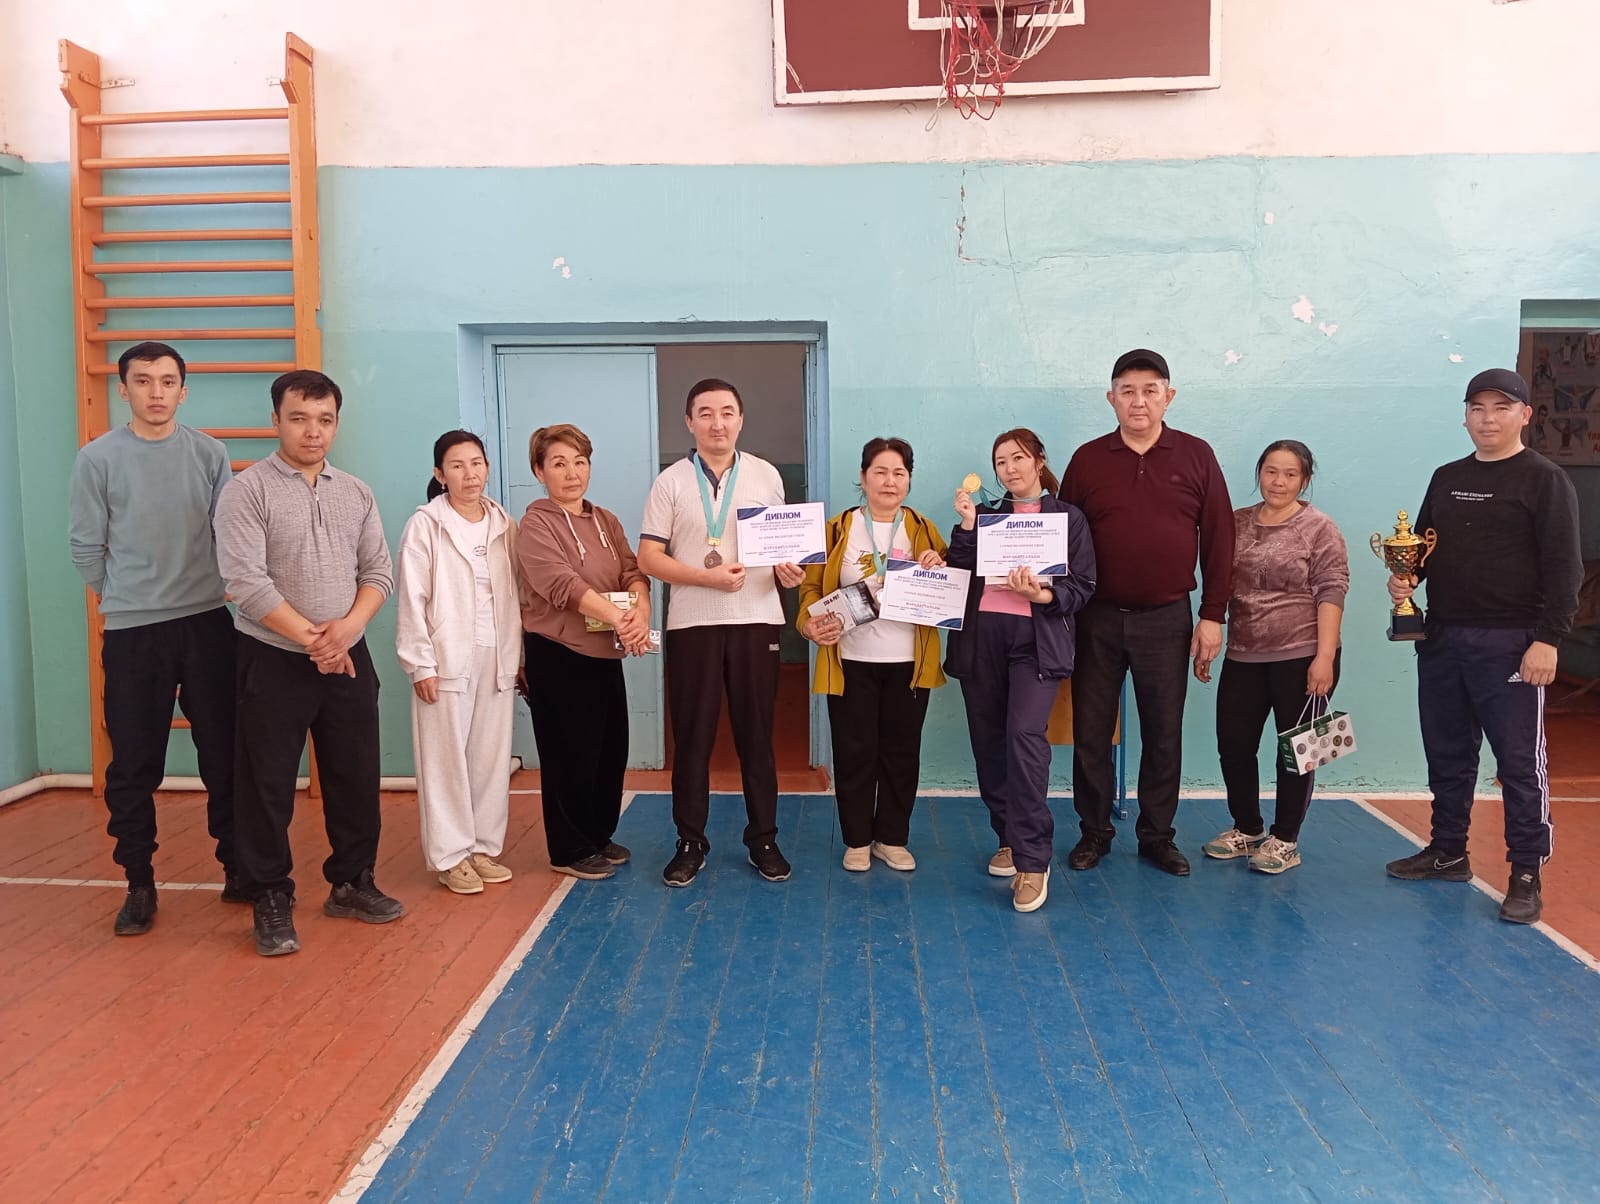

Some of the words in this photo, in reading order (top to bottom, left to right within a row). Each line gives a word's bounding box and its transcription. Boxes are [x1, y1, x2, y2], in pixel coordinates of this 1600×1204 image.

[764, 511, 801, 521] ДИПЛОМ
[1006, 520, 1043, 529] ДИПЛОМ
[912, 569, 948, 581] ДИПЛОМ
